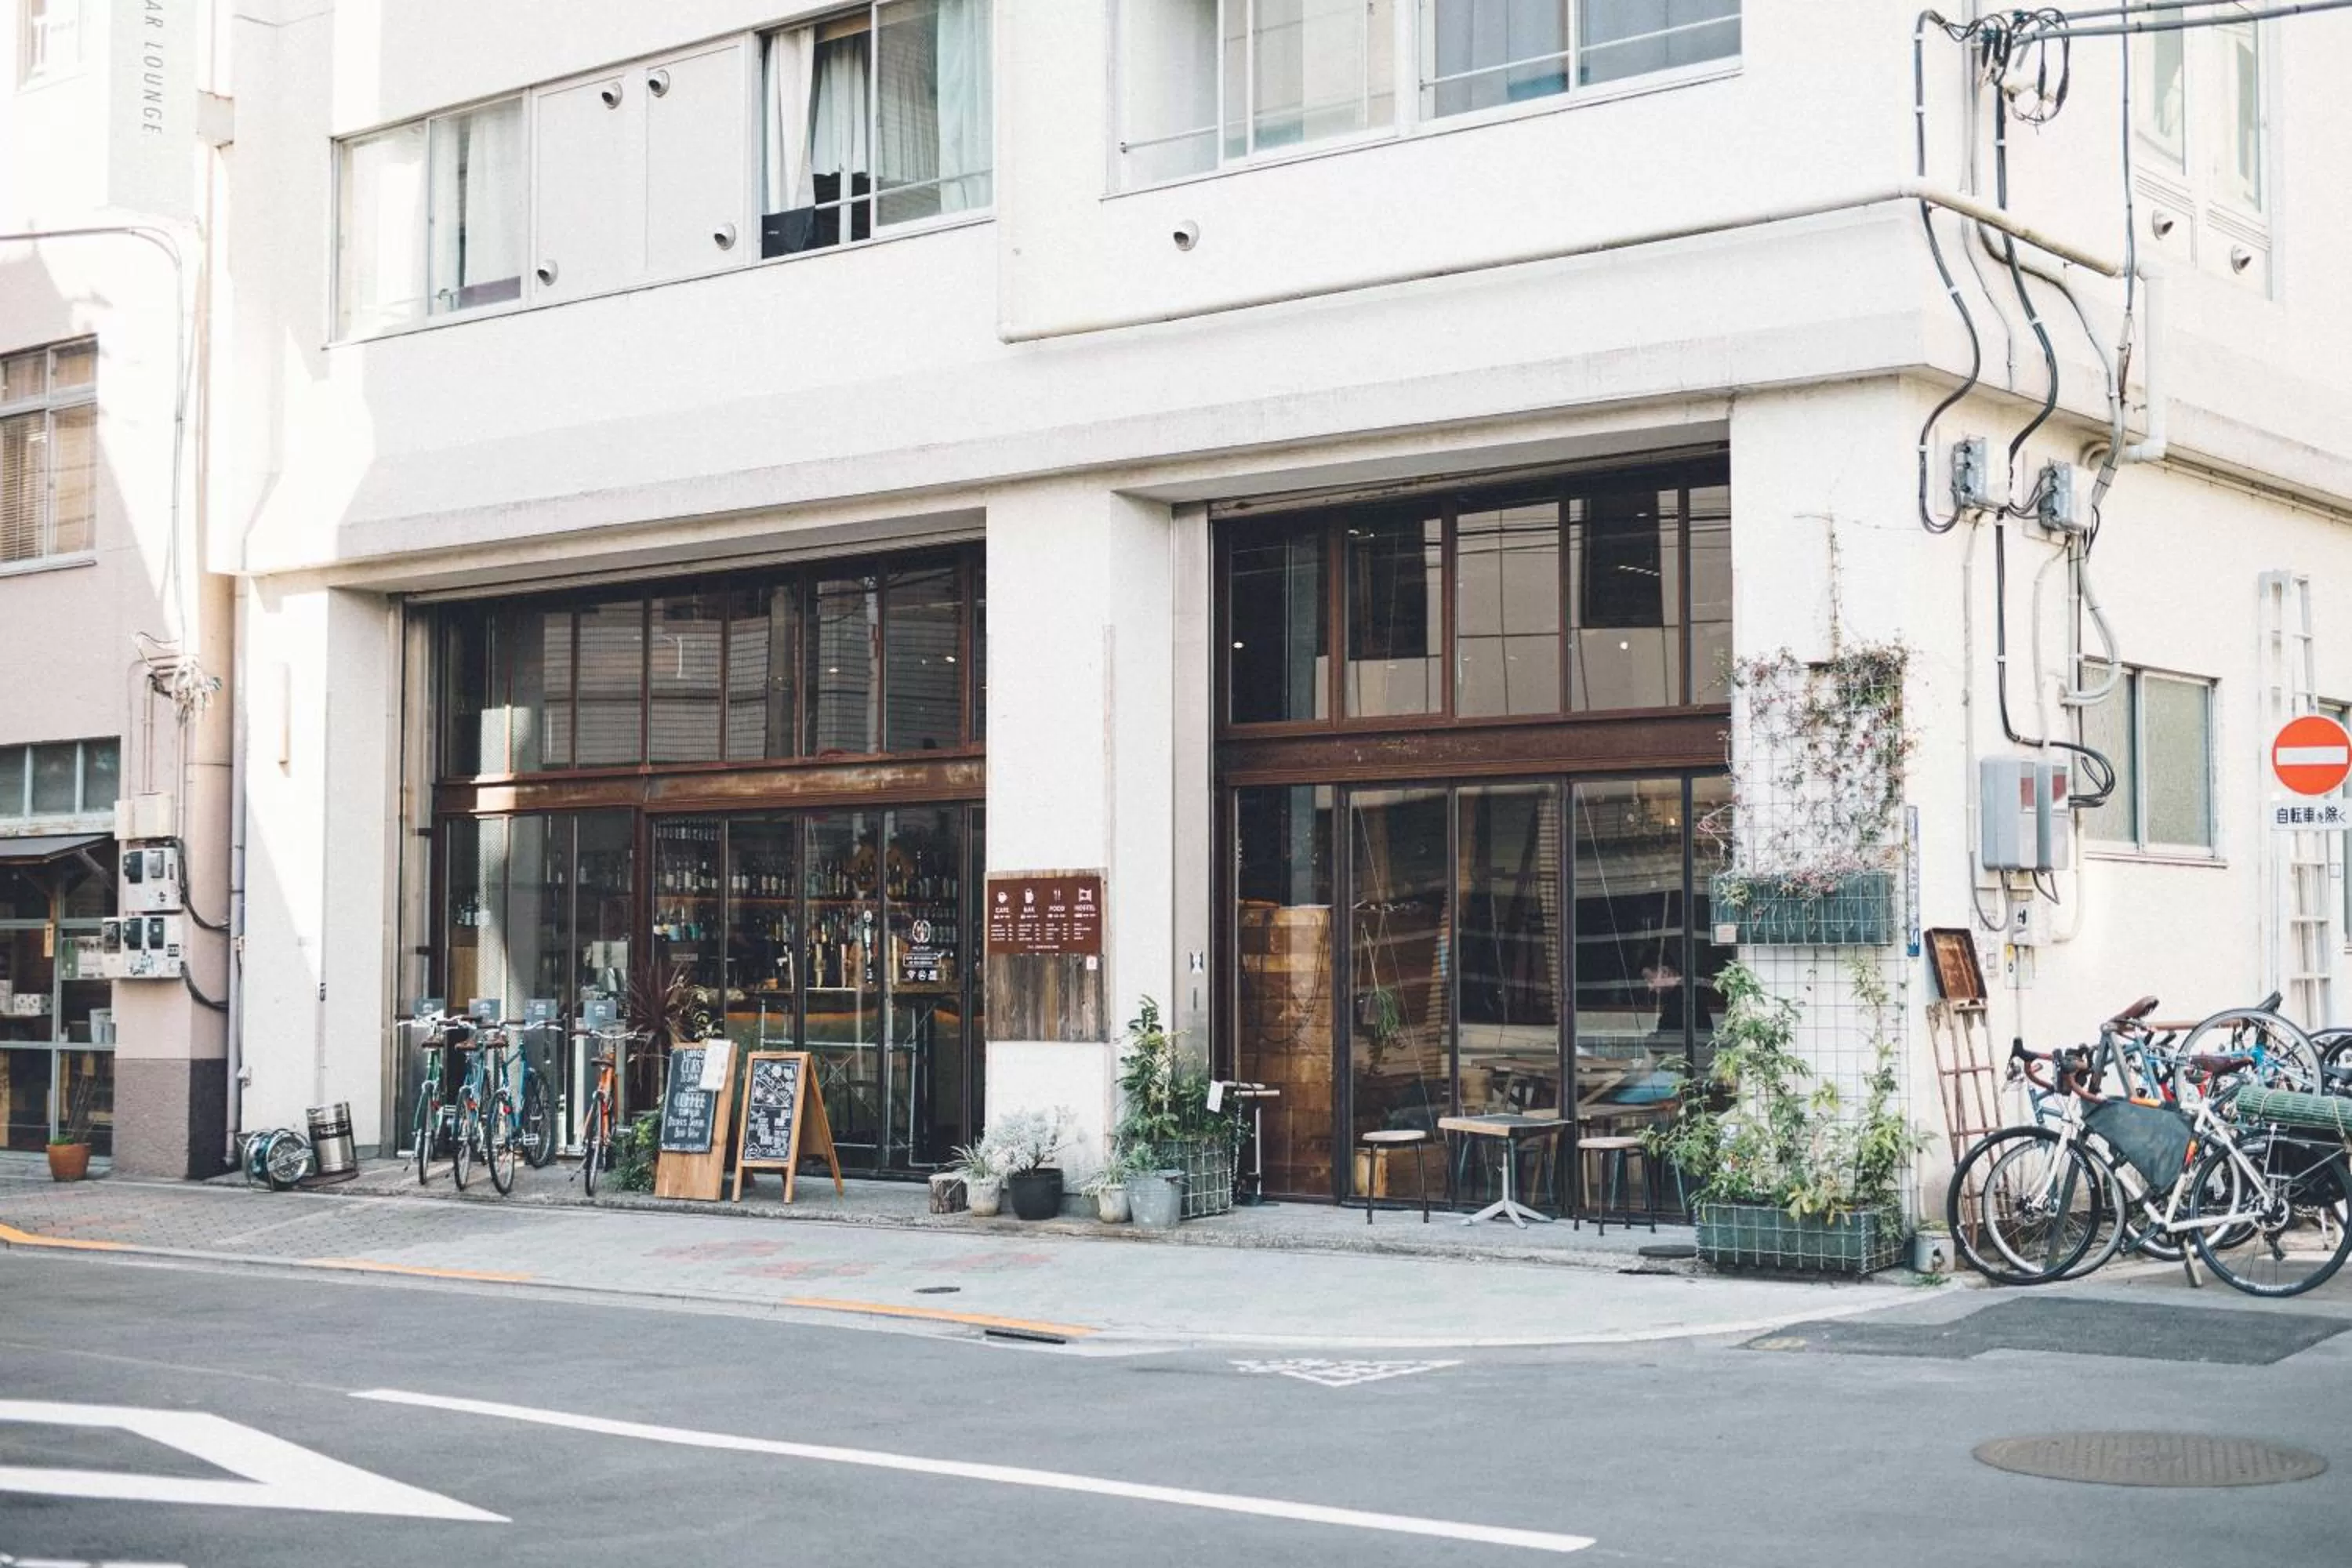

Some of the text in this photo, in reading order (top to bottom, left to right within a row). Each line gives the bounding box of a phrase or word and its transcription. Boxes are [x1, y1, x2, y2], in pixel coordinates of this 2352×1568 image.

[143, 42, 164, 136] LOUNGE
[2276, 806, 2347, 825] 自転車を除く
[673, 1092, 706, 1109] COFFEE
